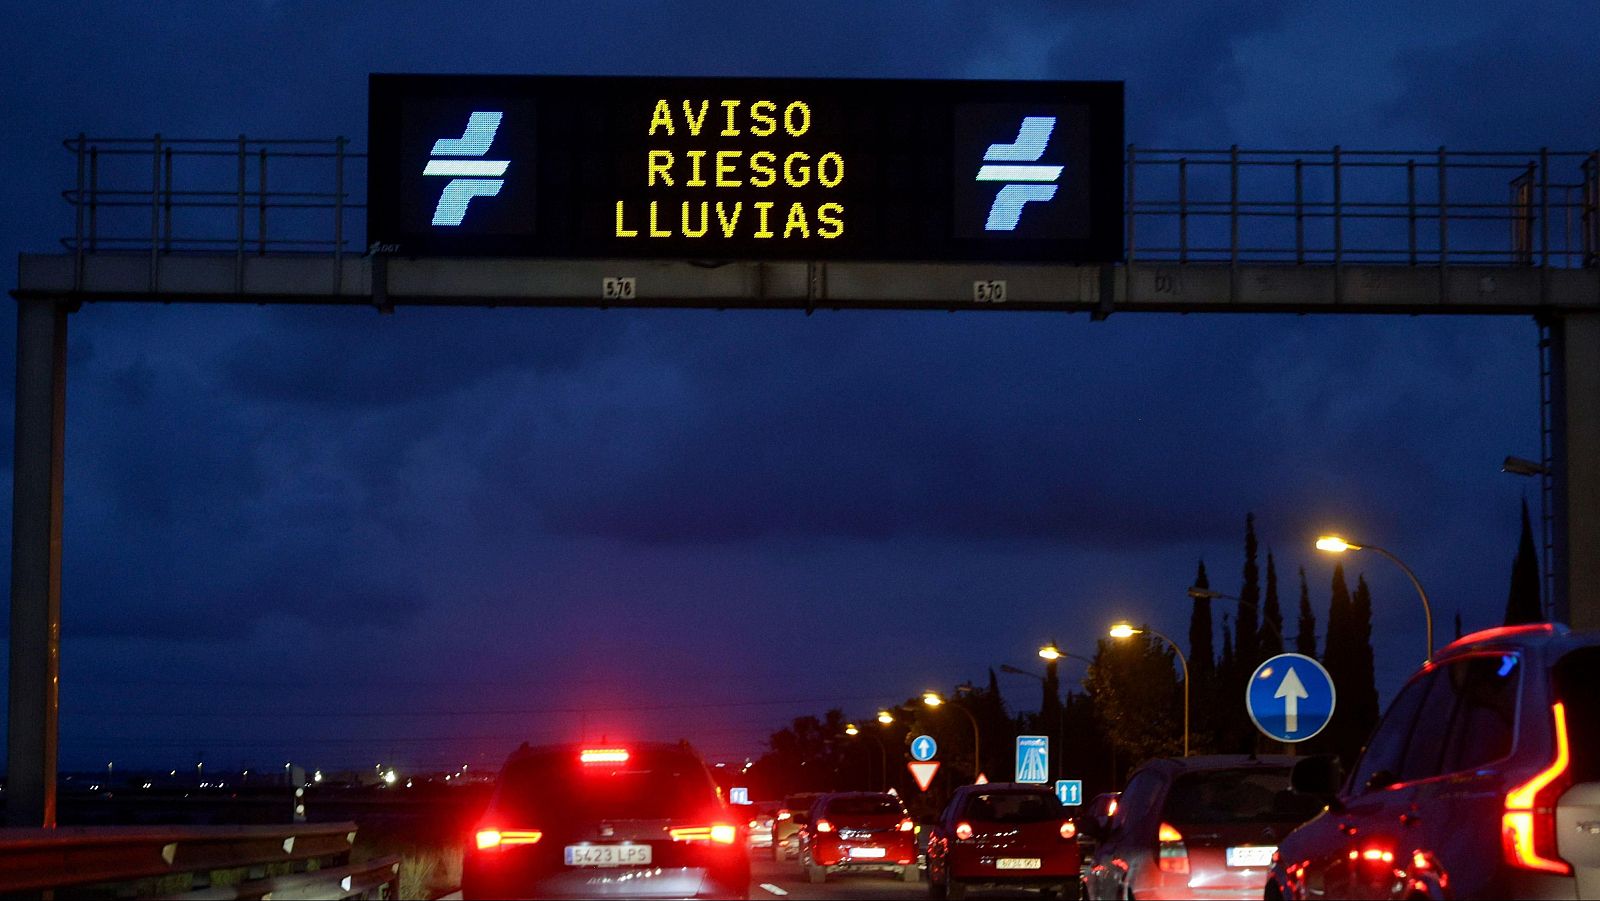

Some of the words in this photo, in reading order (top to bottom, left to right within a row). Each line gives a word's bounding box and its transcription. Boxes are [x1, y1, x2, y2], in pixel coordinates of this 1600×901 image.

[649, 99, 811, 138] AVISO
[648, 150, 845, 189] RIESGO
[615, 200, 845, 239] LLUVIAS
[575, 848, 612, 862] 5423
[618, 848, 646, 861] LPS
